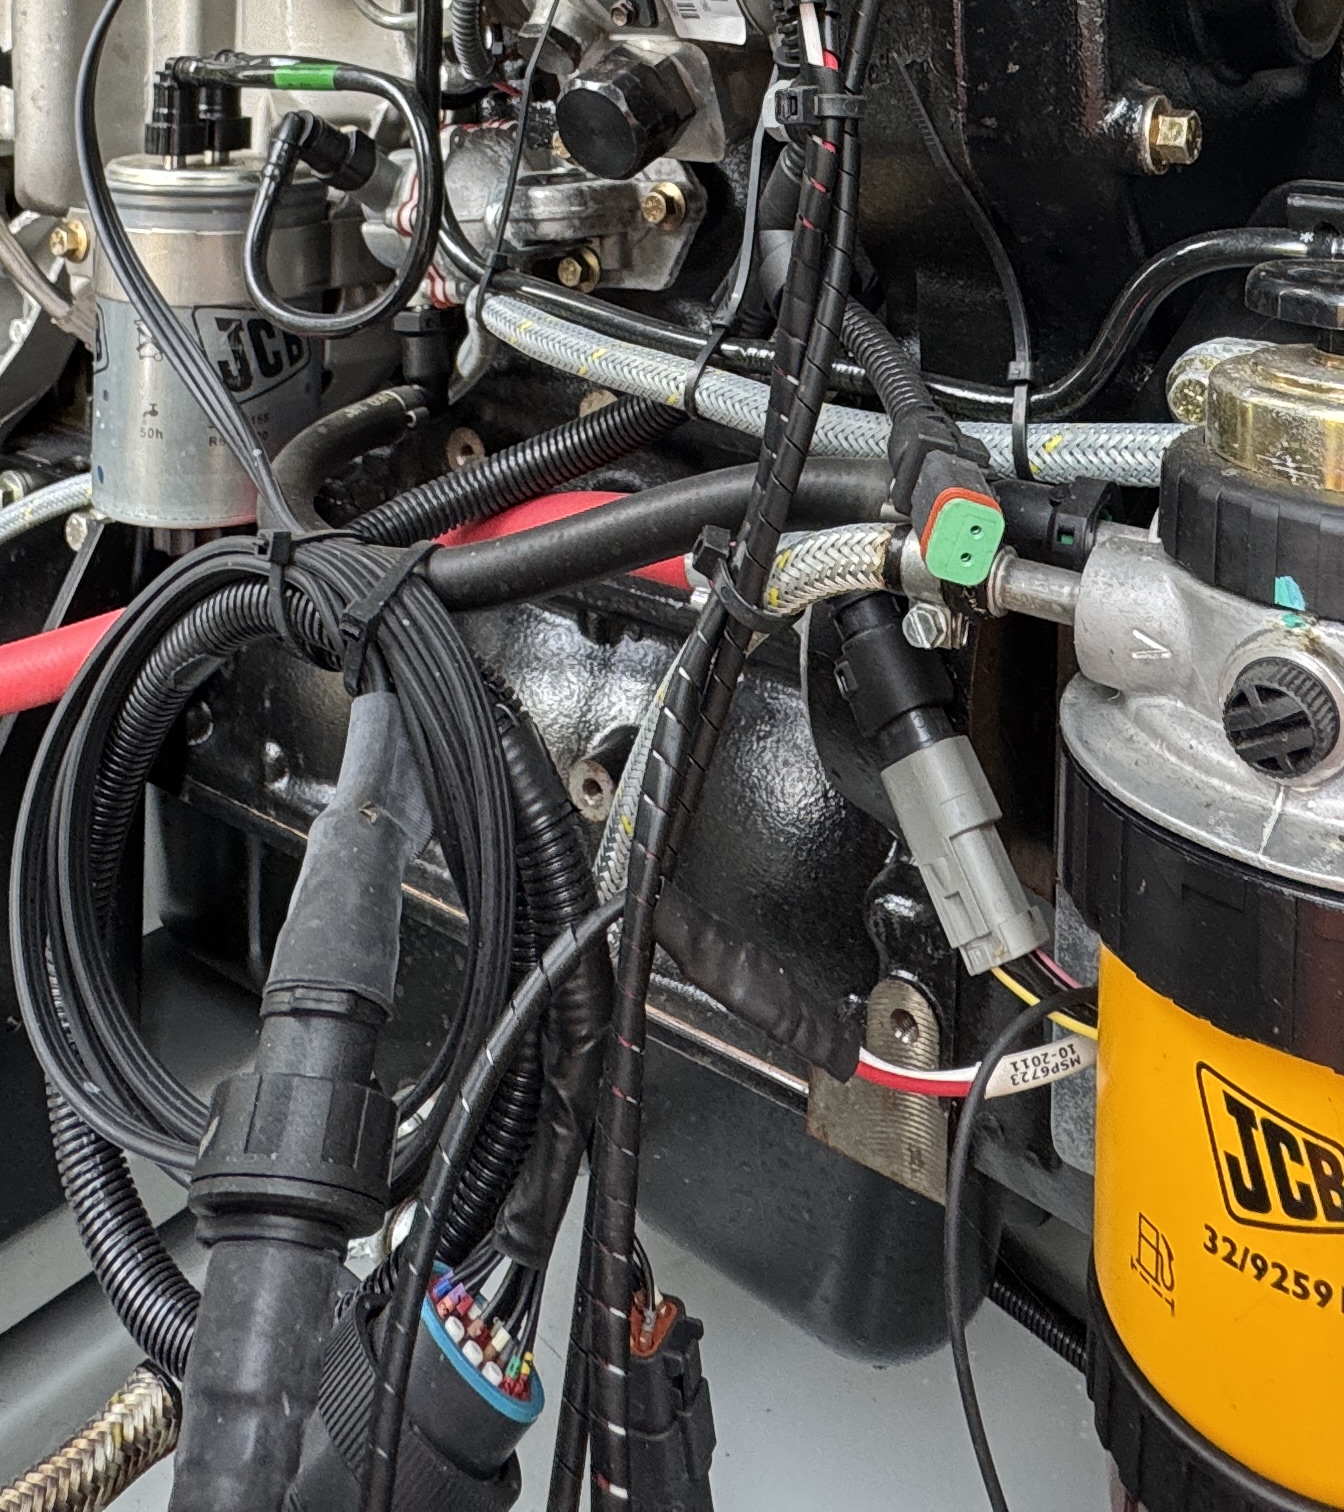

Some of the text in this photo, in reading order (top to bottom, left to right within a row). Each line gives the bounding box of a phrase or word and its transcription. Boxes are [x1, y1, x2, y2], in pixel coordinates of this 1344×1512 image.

[214, 316, 306, 392] JCB
[1010, 1043, 1076, 1073] 10-2011
[1010, 1055, 1081, 1086] MSP6723
